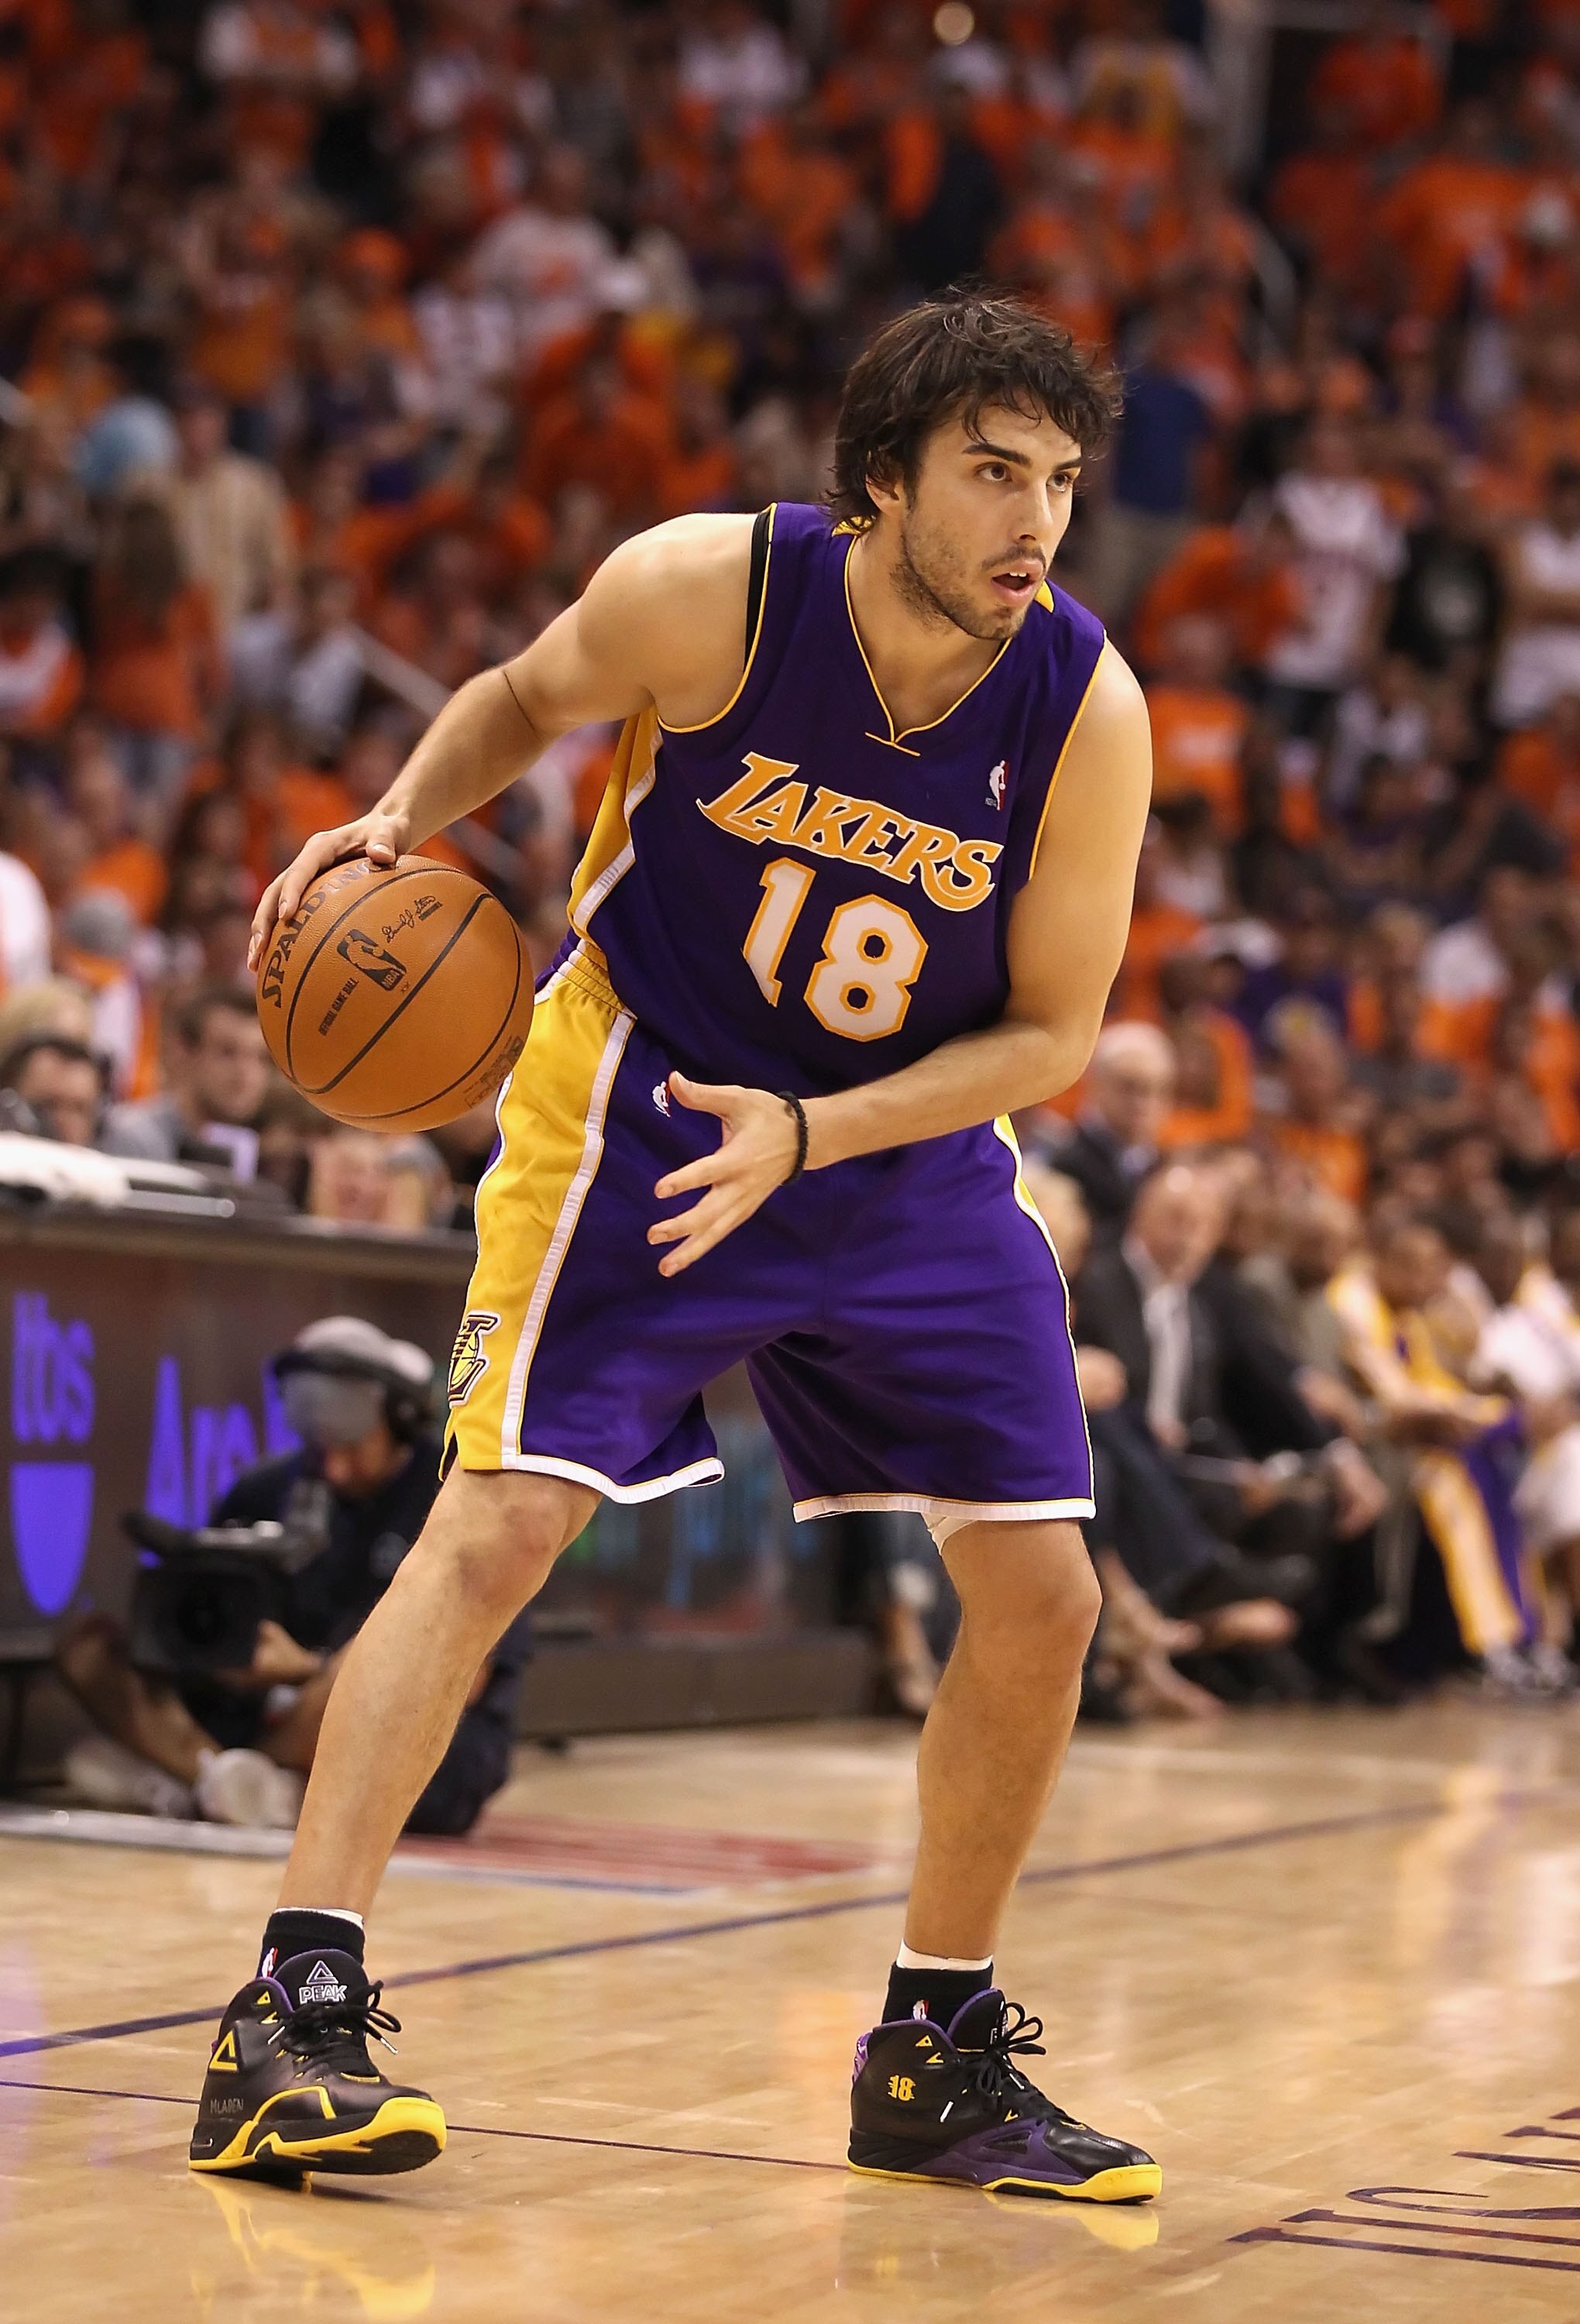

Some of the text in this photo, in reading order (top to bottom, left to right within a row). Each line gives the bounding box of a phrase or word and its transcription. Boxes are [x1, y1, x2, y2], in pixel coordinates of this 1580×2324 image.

[697, 751, 1004, 912] LAKERS
[740, 857, 929, 1042] 18
[331, 992, 348, 1012] GAME
[342, 977, 359, 995] BALL
[381, 968, 401, 989] NBA
[12, 1291, 94, 1443] tbs
[298, 1985, 348, 2005] PEAK
[888, 2075, 916, 2101] 18
